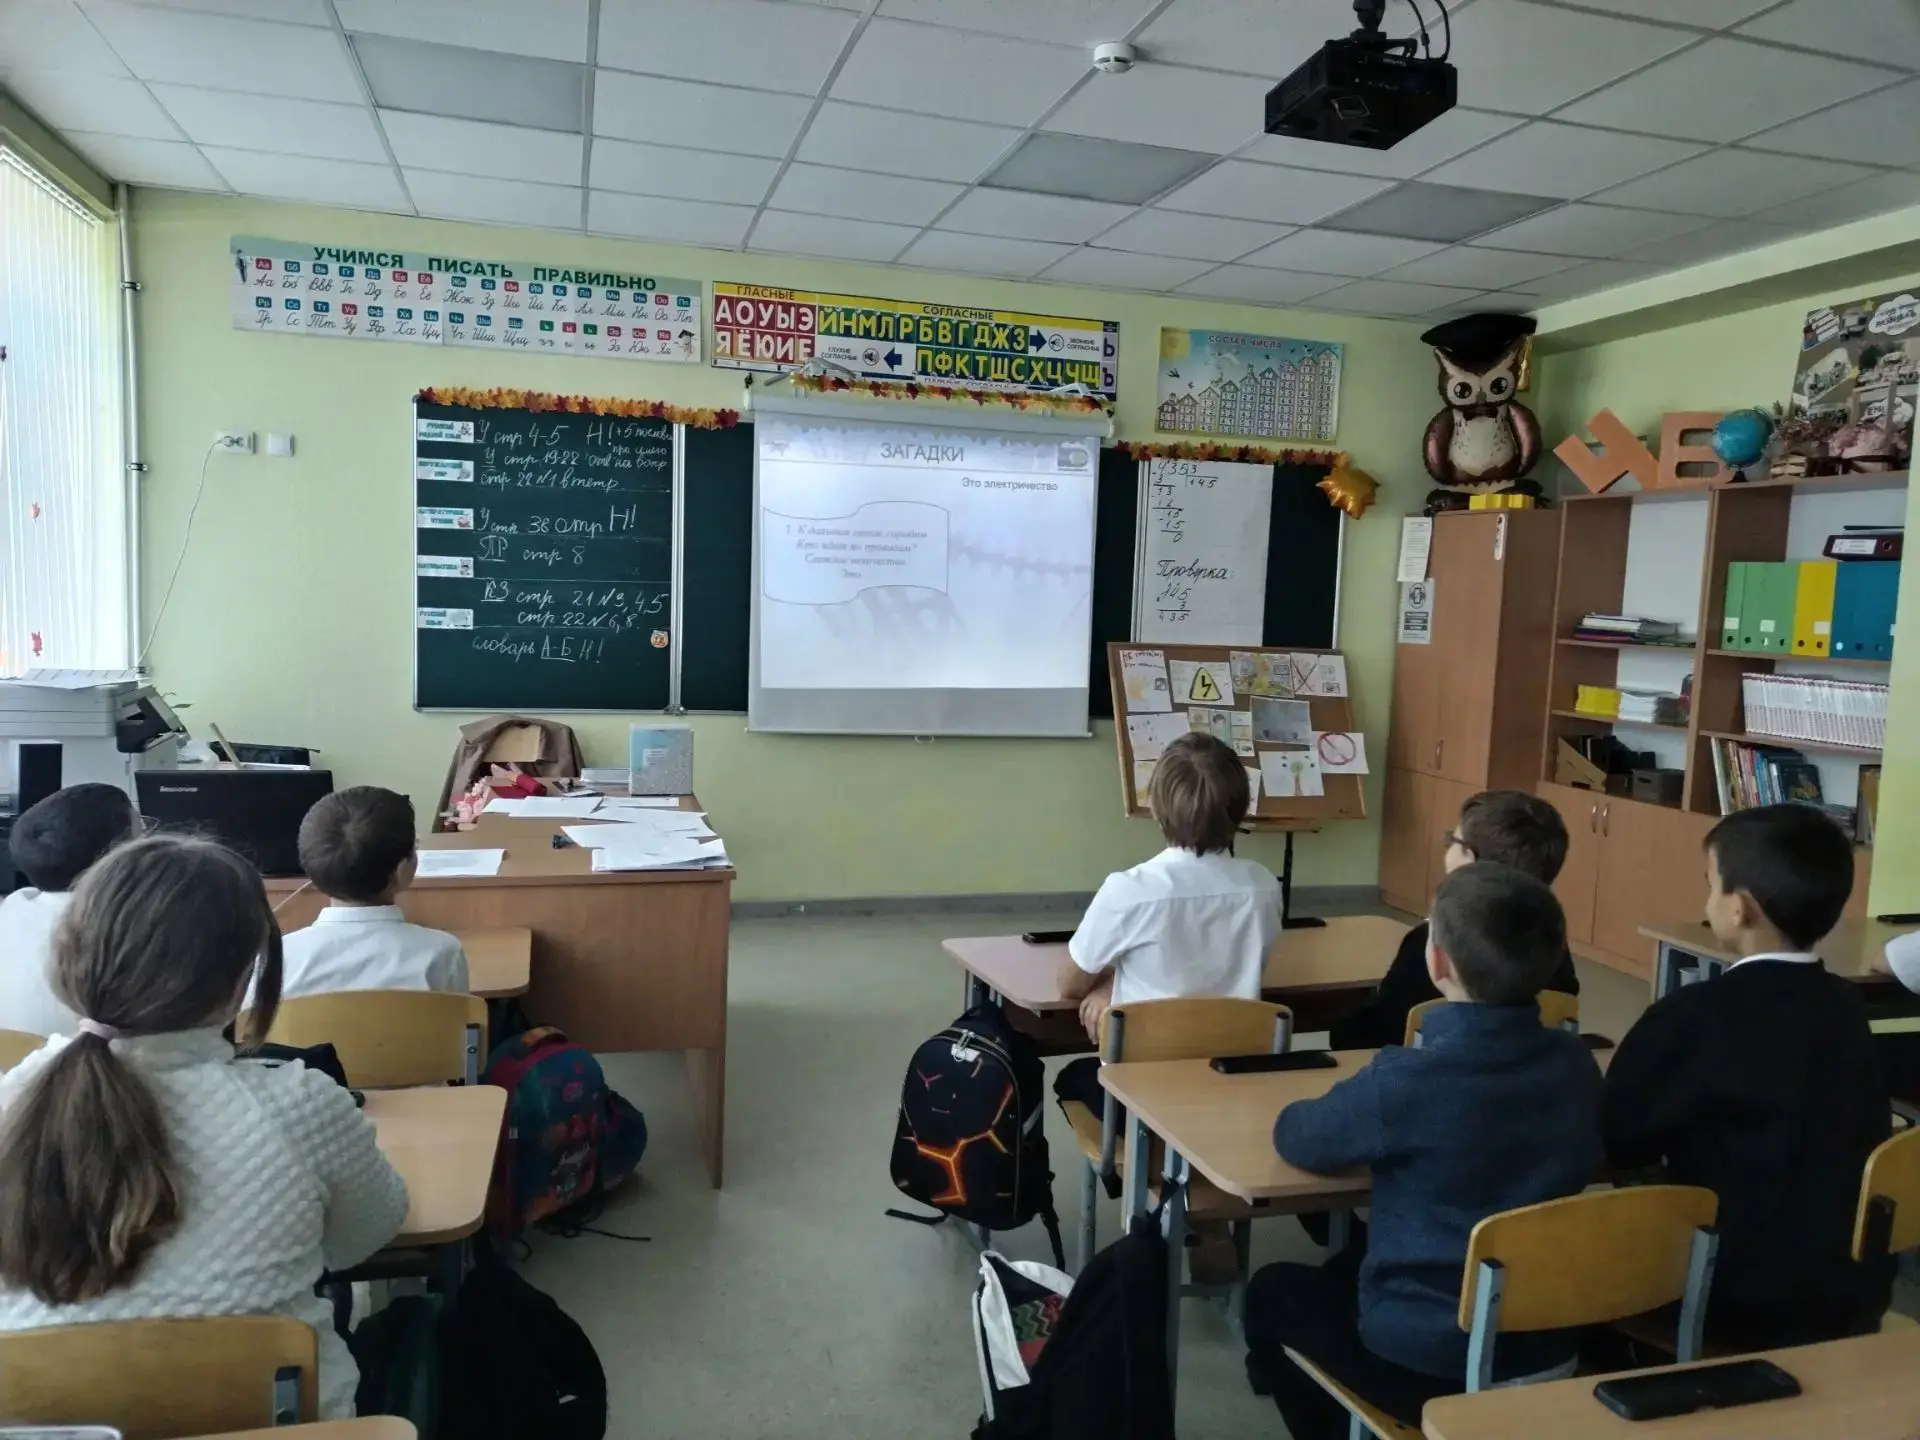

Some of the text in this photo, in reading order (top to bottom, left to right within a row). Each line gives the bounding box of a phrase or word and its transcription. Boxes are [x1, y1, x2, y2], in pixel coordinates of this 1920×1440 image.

[314, 246, 657, 291] УЧИМСЯ ПИСАТЬ ПРАВИЛЬНО
[736, 286, 796, 300] ГЛАСНЫЕ
[922, 305, 995, 321] СОГЛАСНЫЕ
[880, 442, 965, 464] ЗАГАДКИ
[961, 477, 1058, 491] Это электричество
